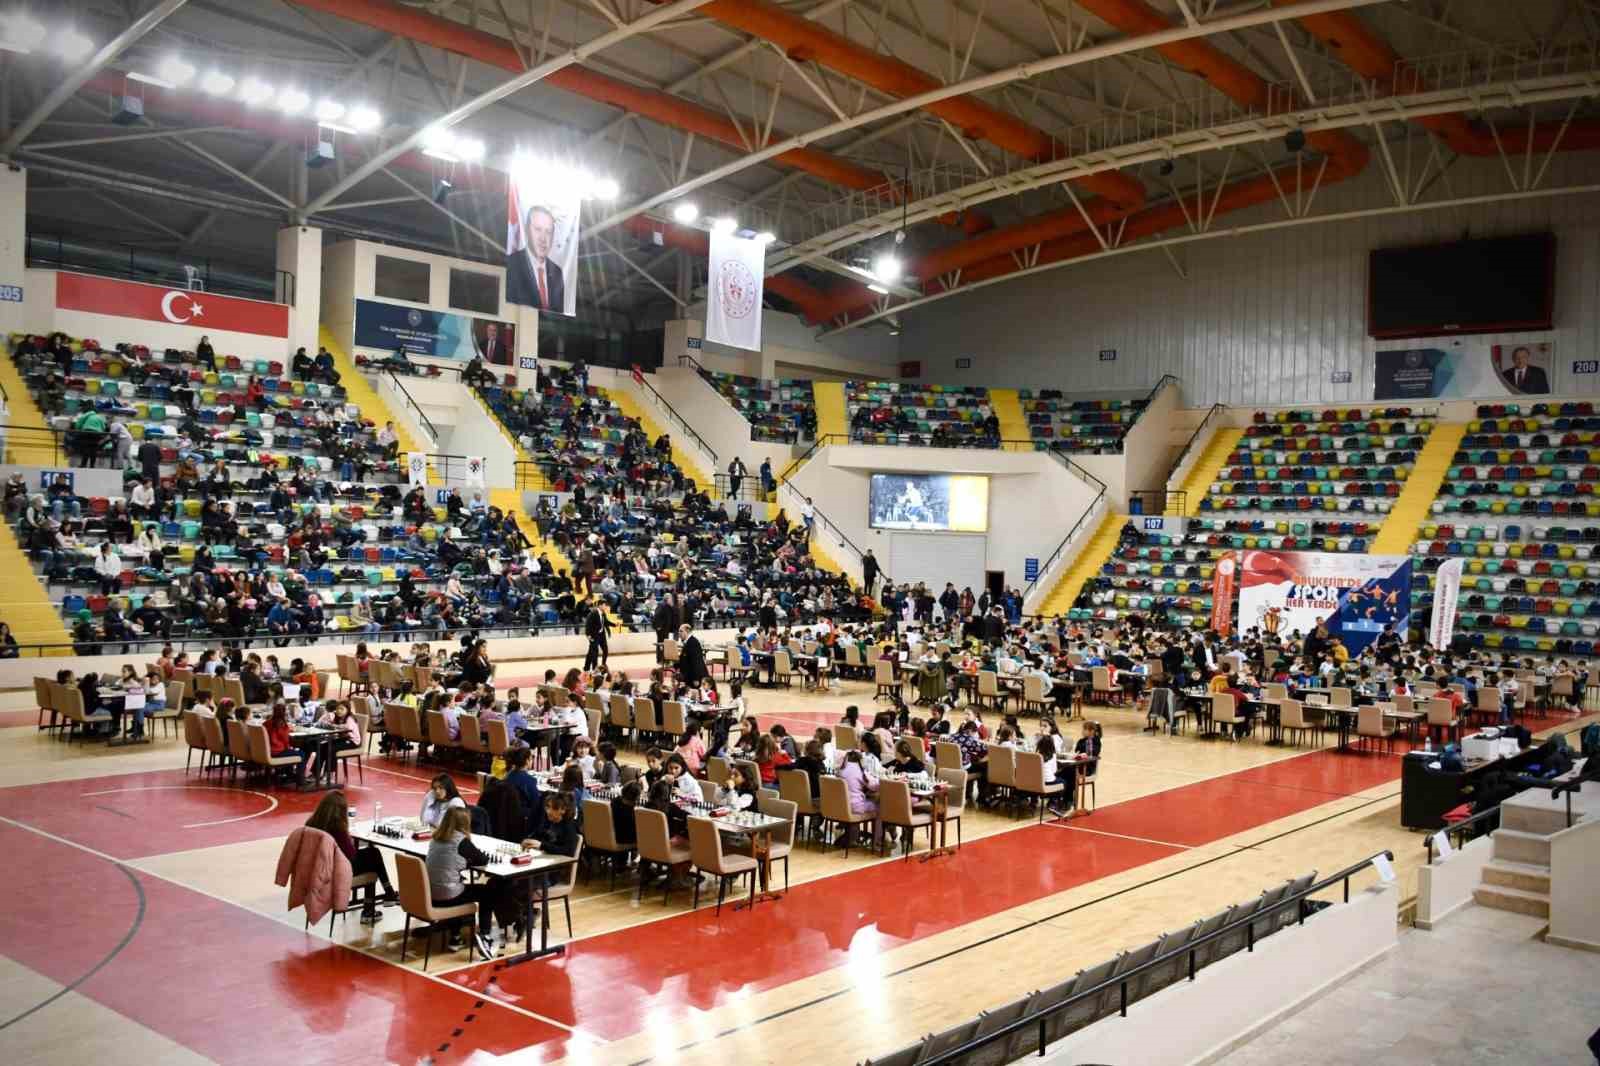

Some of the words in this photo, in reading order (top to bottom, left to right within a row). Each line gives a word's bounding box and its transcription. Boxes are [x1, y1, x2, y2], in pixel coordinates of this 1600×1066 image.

[521, 358, 535, 368] 206
[1575, 362, 1595, 373] 208
[1146, 519, 1161, 528] 107
[1293, 585, 1339, 602] SPOR
